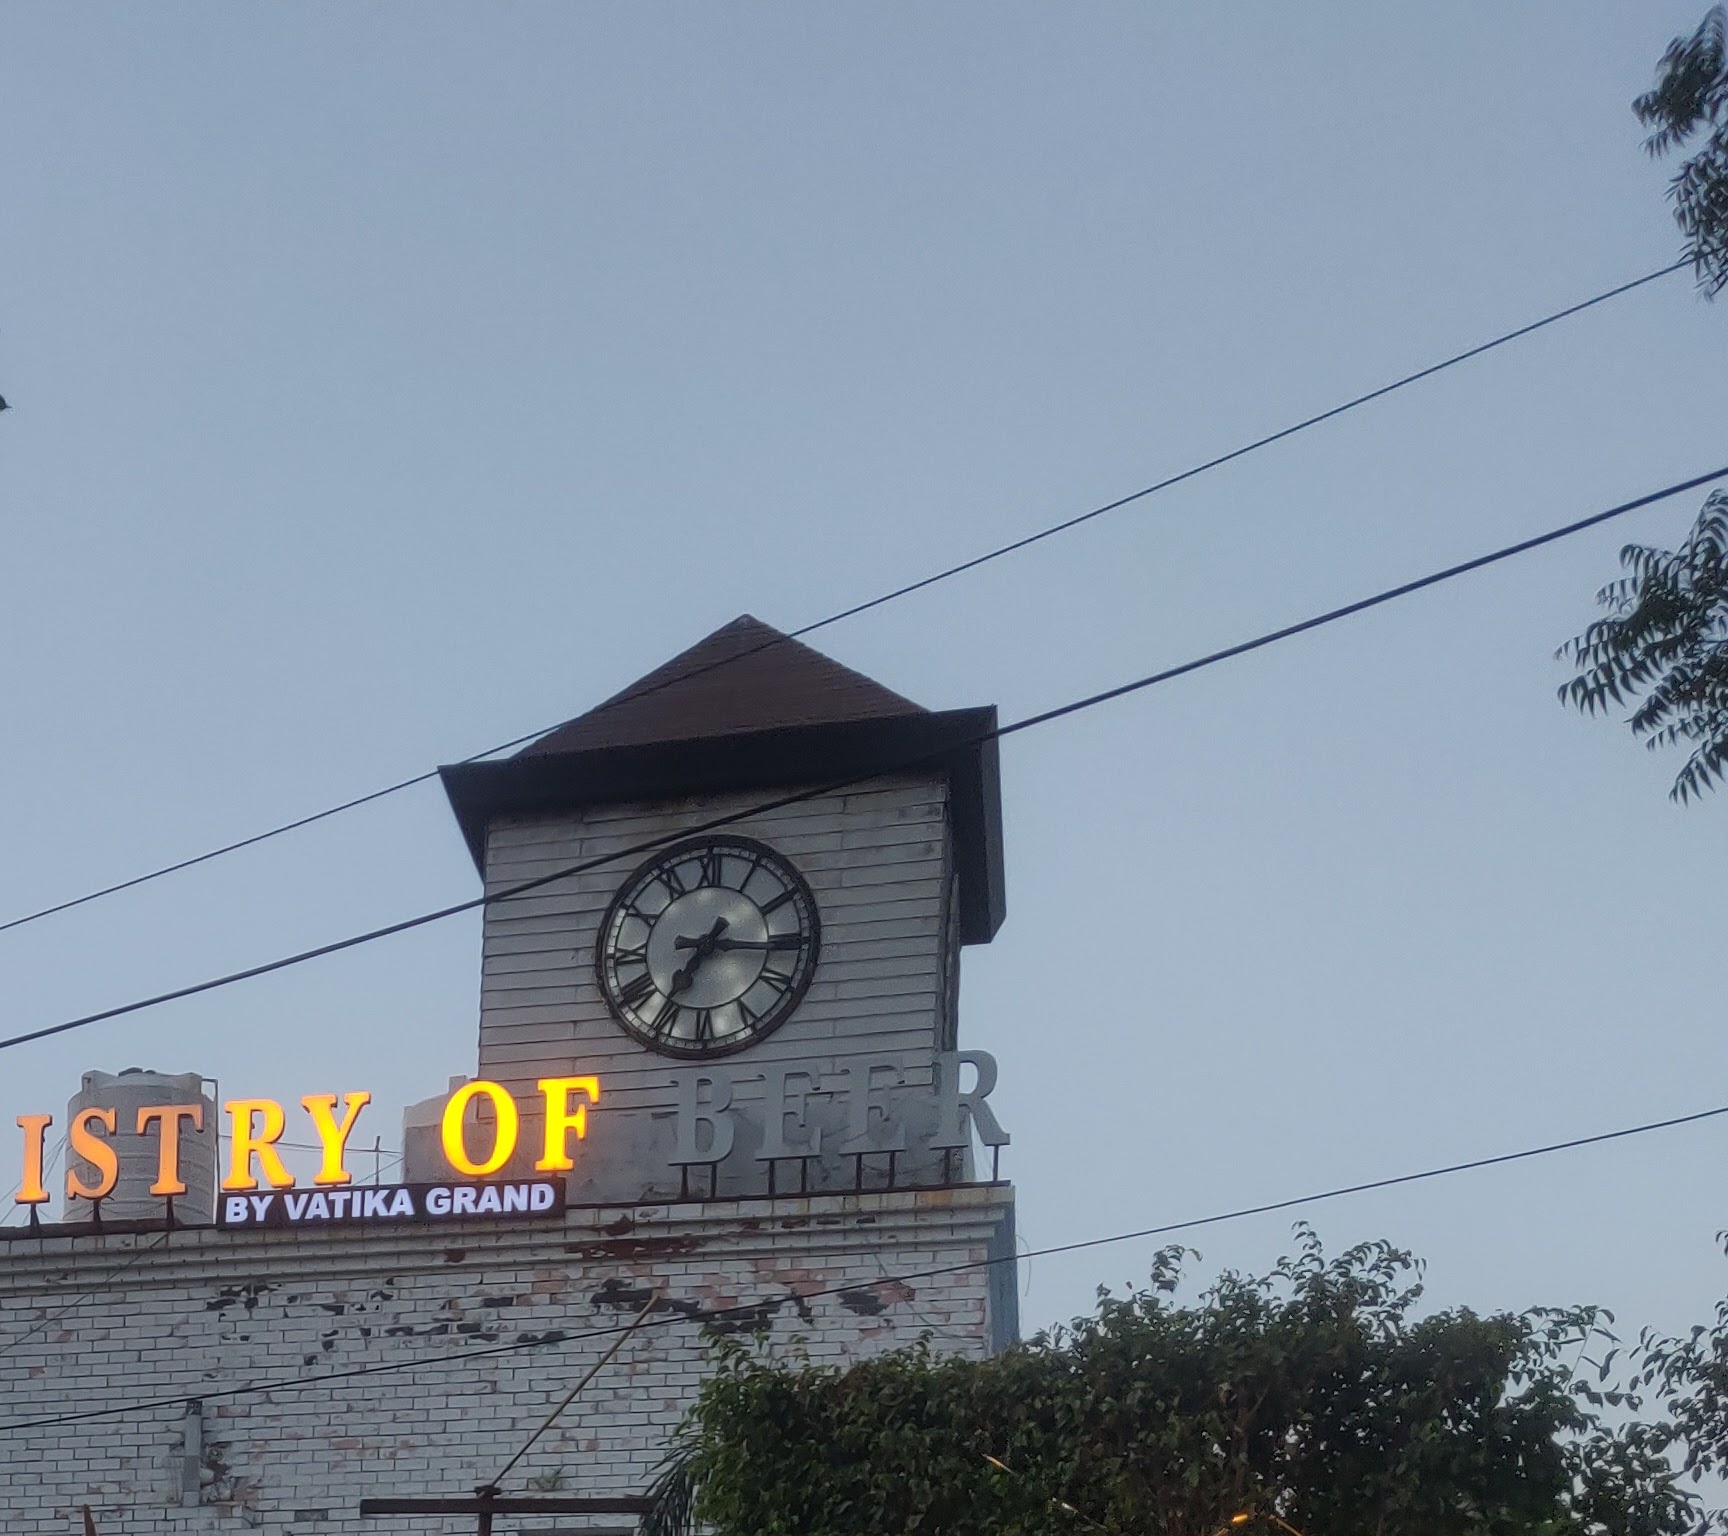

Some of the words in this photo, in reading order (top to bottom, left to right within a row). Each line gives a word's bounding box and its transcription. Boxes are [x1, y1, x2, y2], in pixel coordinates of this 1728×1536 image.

[441, 1076, 600, 1176] OF
[667, 1049, 1011, 1166] BEER
[225, 1196, 274, 1223] BY
[283, 1188, 415, 1221] VATIKA
[425, 1183, 555, 1214] GRAND
